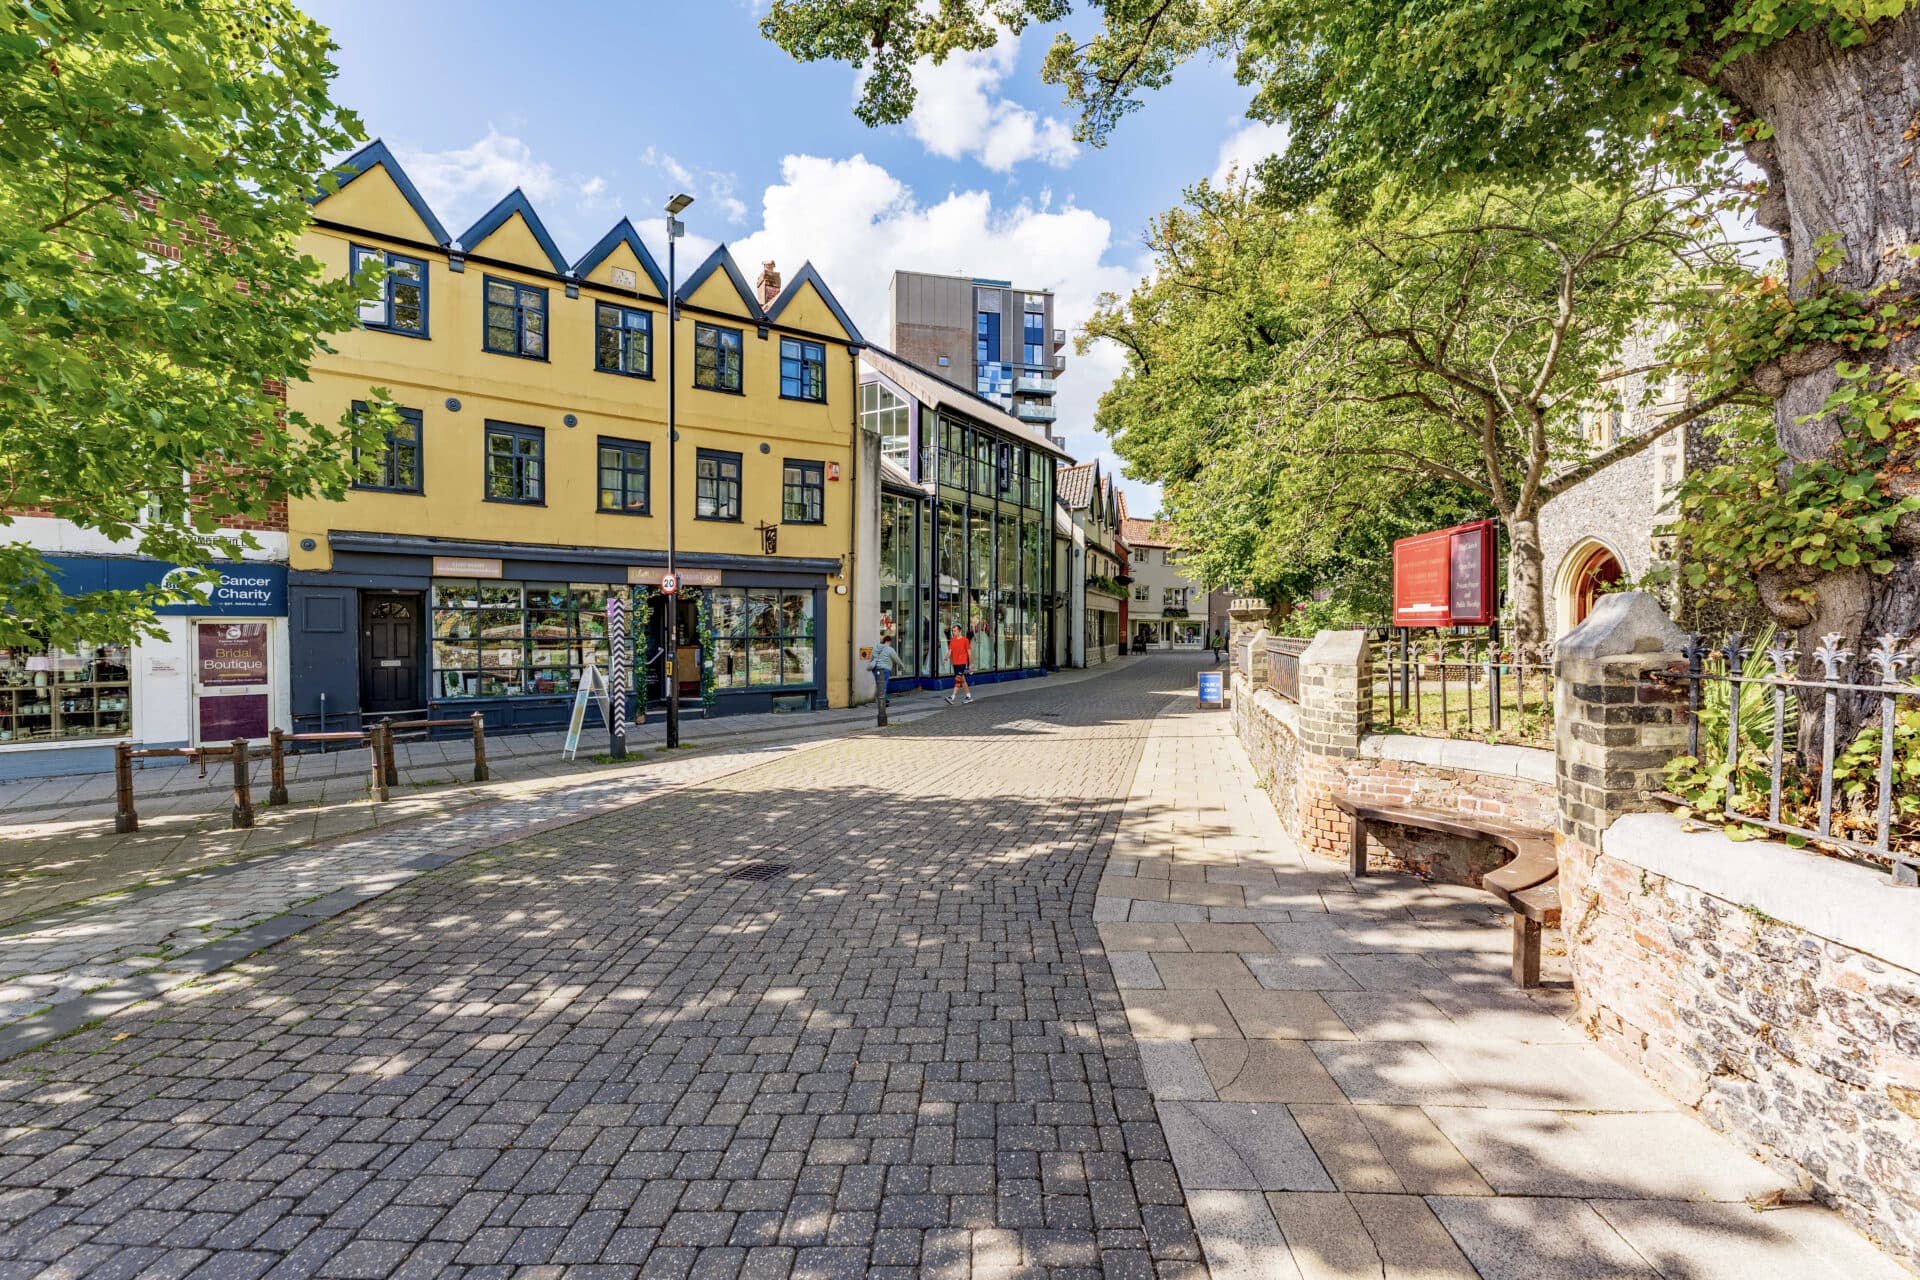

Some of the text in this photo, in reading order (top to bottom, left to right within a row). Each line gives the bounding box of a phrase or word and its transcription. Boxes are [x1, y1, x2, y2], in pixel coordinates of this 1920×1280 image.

[219, 575, 271, 586] Cancer
[664, 579, 674, 588] 20
[218, 588, 271, 601] Charity
[216, 648, 251, 658] Bridal
[204, 660, 262, 671] Boutique
